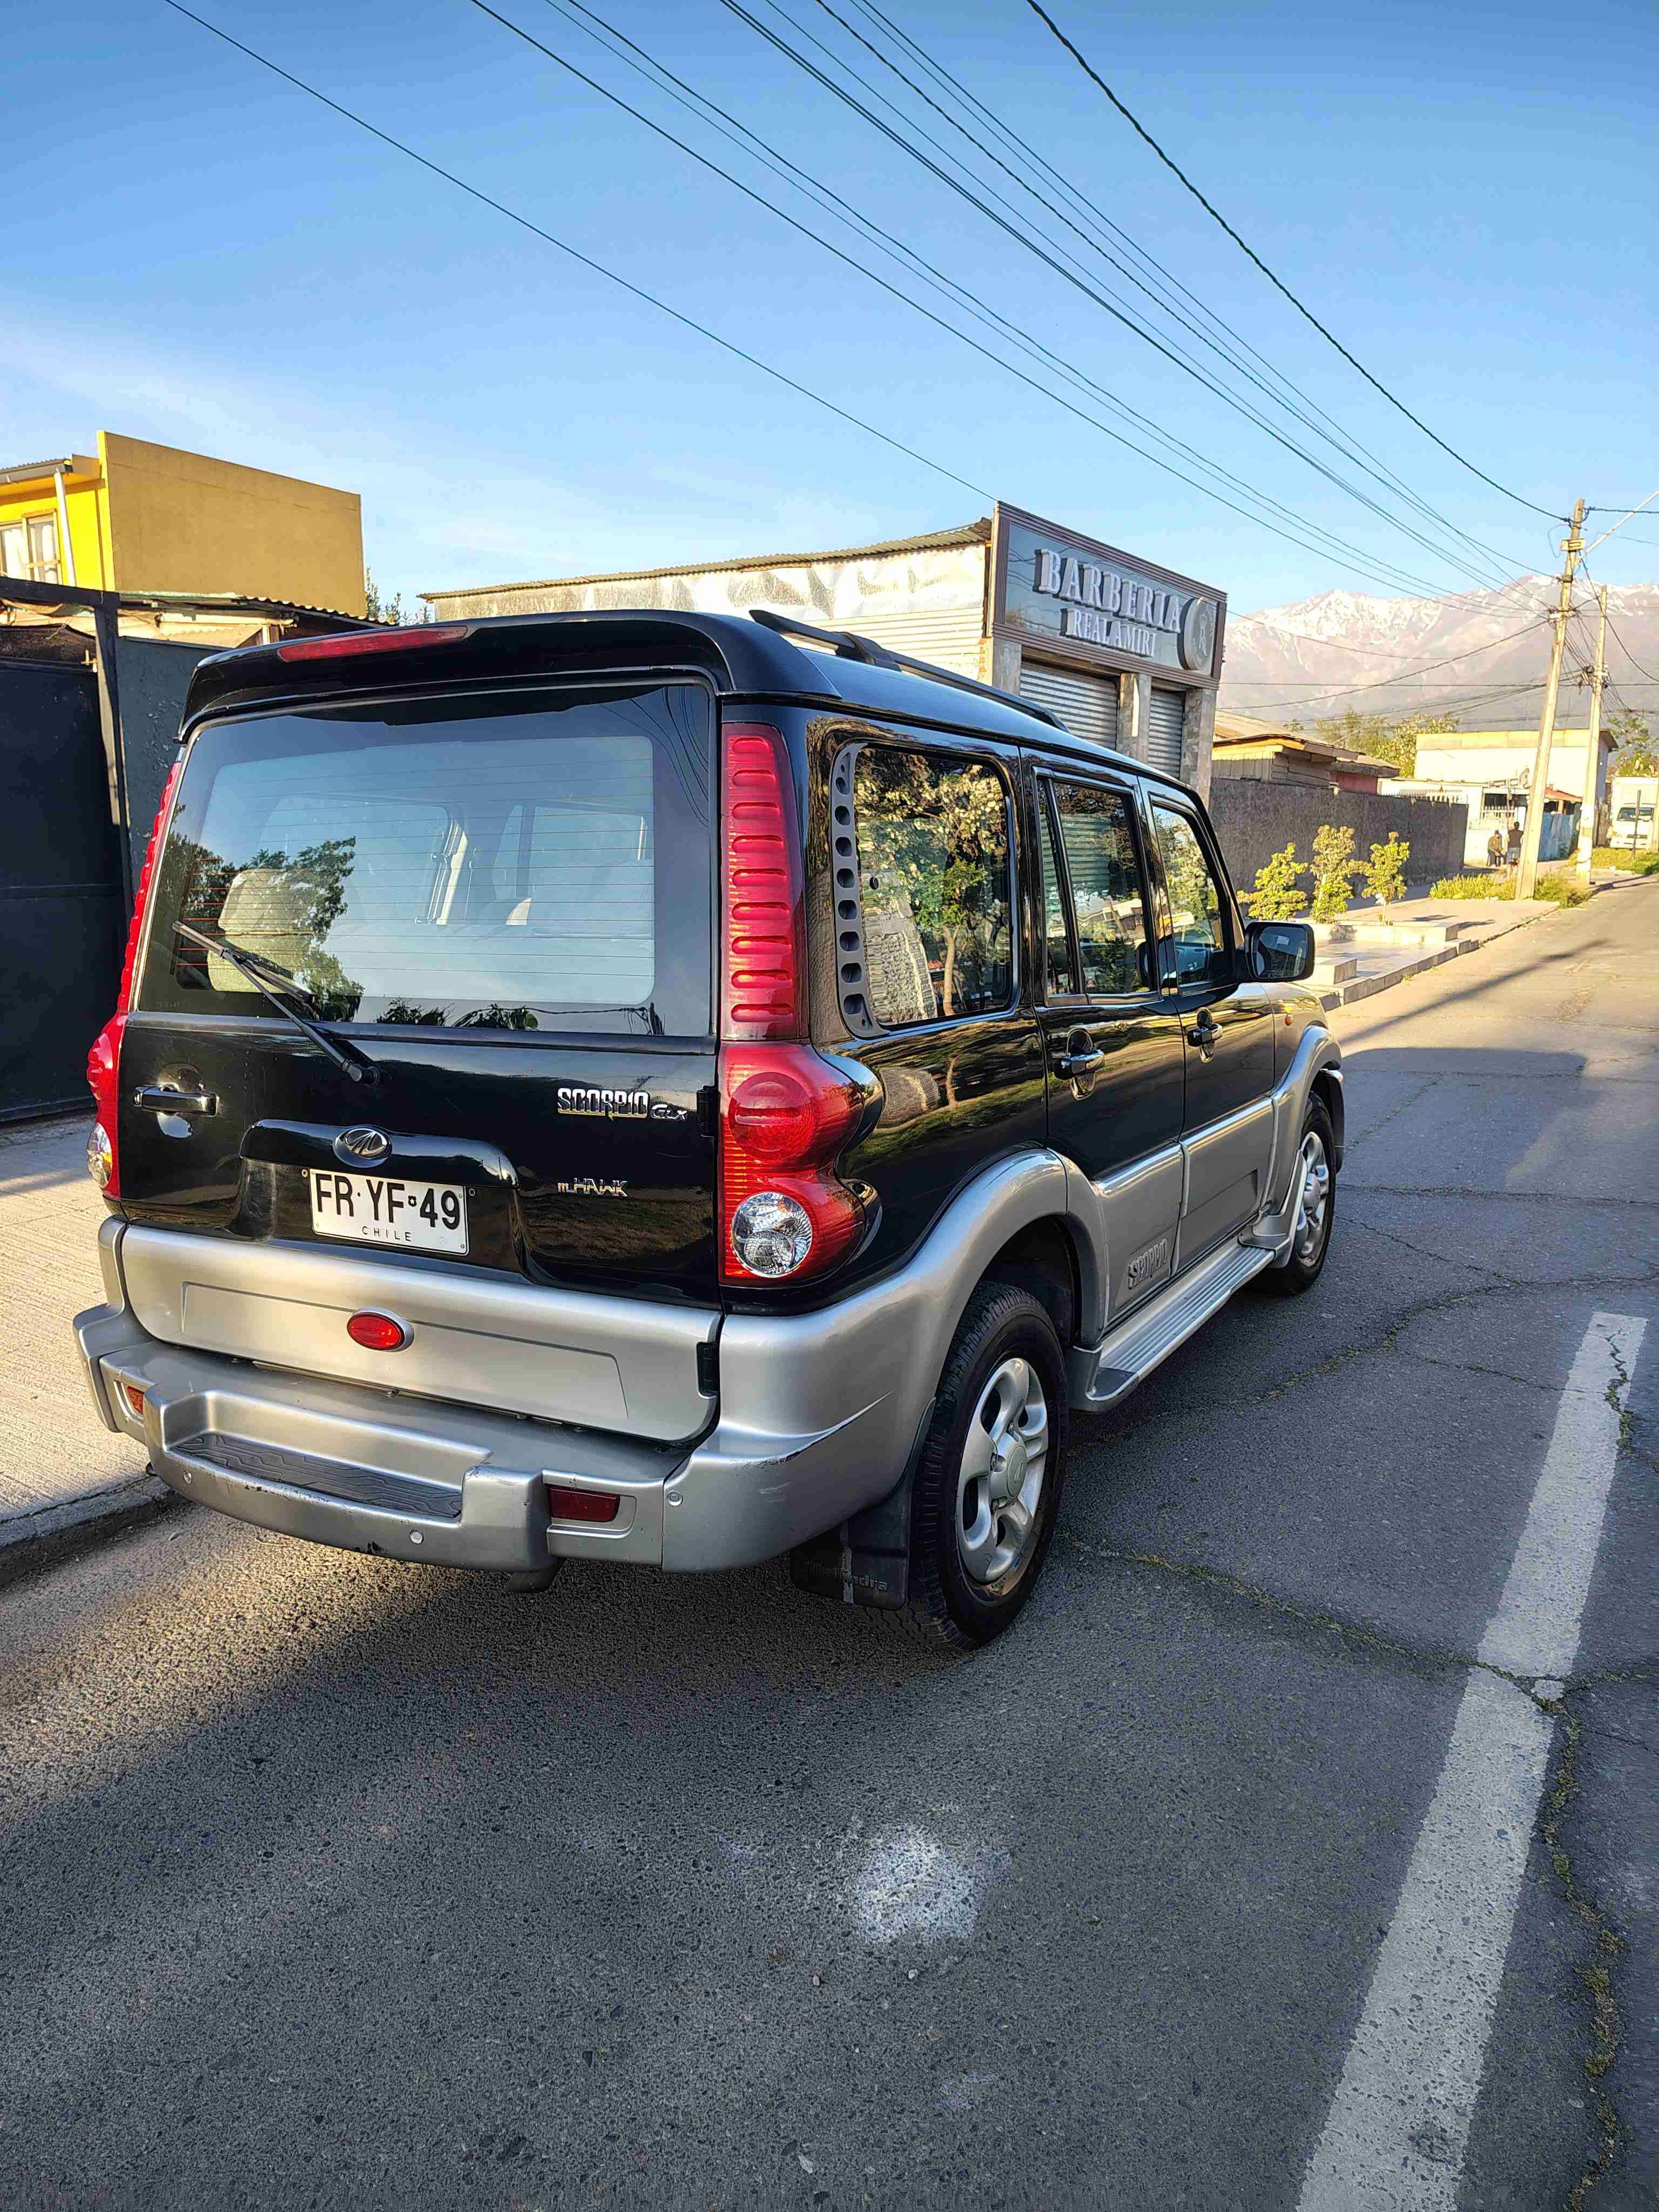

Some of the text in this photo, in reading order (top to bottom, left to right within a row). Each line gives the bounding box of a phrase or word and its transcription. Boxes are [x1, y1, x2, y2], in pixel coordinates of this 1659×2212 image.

[1065, 609, 1157, 657] REAL AMIRI
[557, 1088, 649, 1121] SCORPIO
[362, 1225, 412, 1242] CHILE
